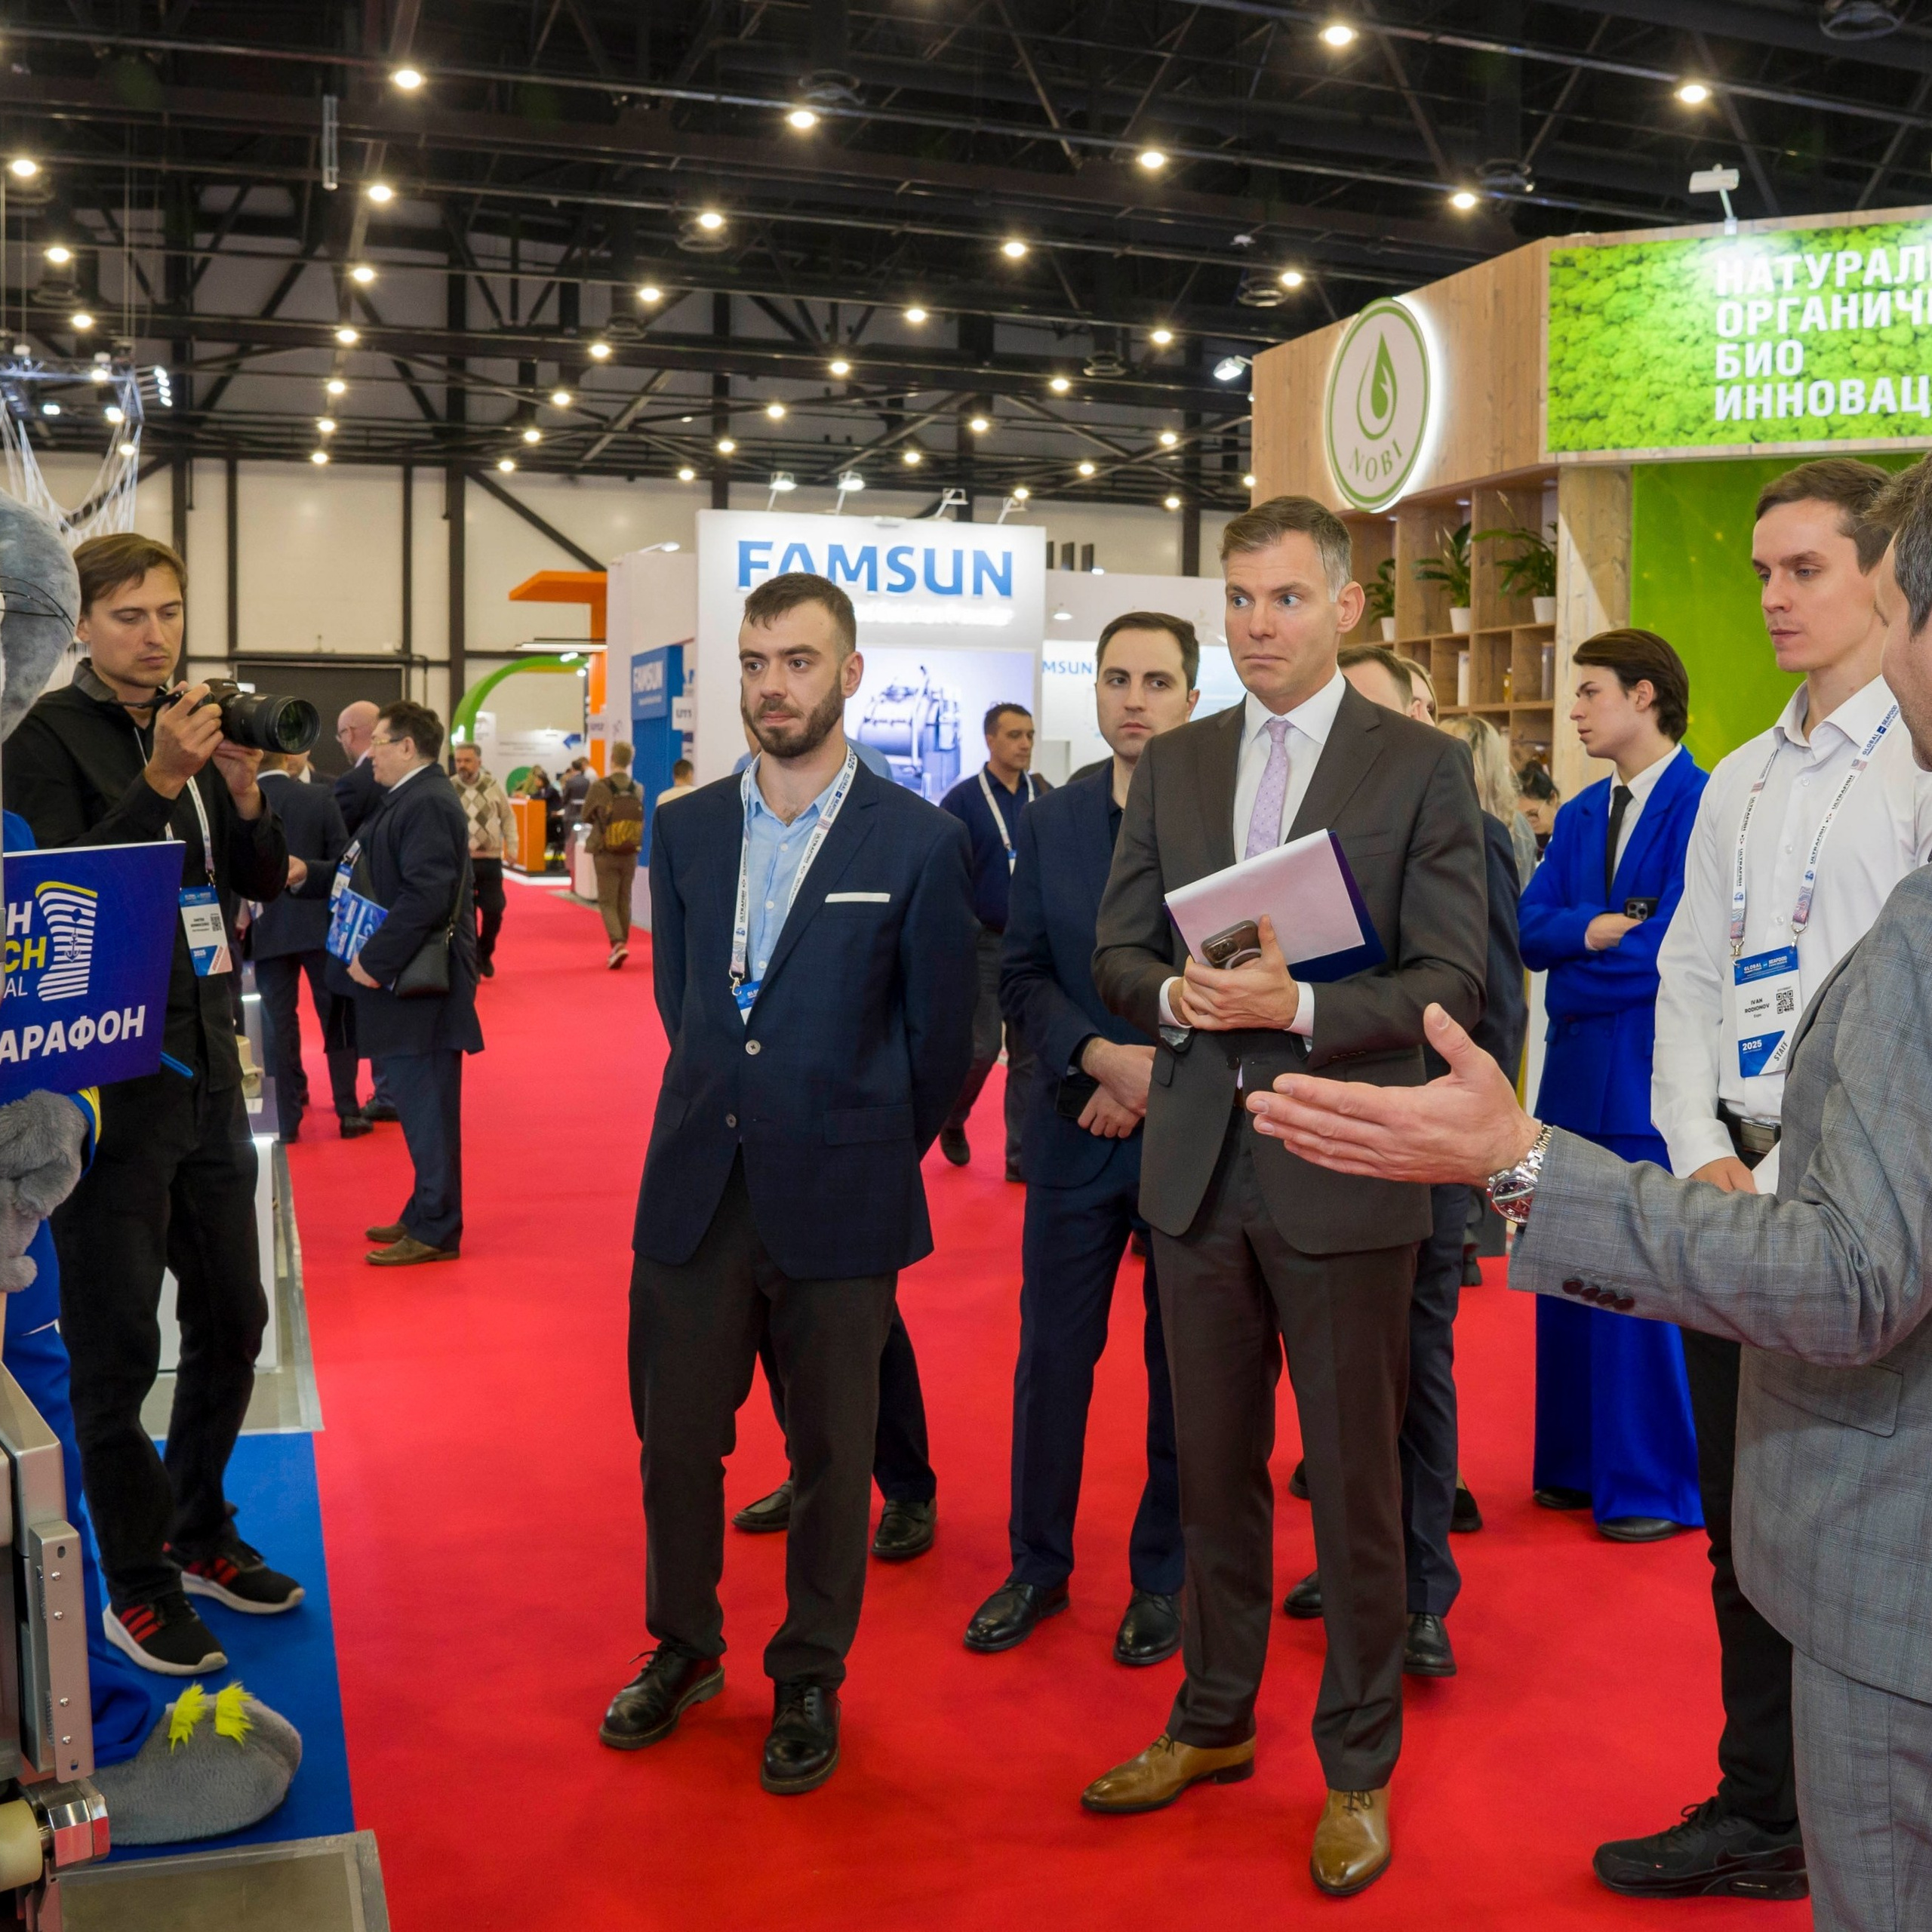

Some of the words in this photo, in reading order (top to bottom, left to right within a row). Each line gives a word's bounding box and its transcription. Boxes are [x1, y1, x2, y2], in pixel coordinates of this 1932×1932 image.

[1716, 245, 1932, 297] НАТУРАЛ
[1716, 340, 1804, 380] БИО
[1715, 374, 1931, 422] ИННОВАЦ
[1349, 438, 1402, 483] NOBI
[737, 540, 1013, 597] FAMSUN
[1862, 734, 1879, 755] GLOBAL
[1881, 704, 1898, 725] SEAFOOD
[1744, 797, 1756, 831] ULTRAFISH
[1810, 826, 1826, 864] ULTRAFISH
[1832, 774, 1854, 810] ULTRAFISH
[1743, 963, 1762, 972] GLOBAL
[1768, 955, 1788, 964] SEAFOOD
[1744, 1003, 1770, 1013] RODIONOV
[1742, 1039, 1763, 1051] 2025
[1774, 1041, 1789, 1061] STAFF
